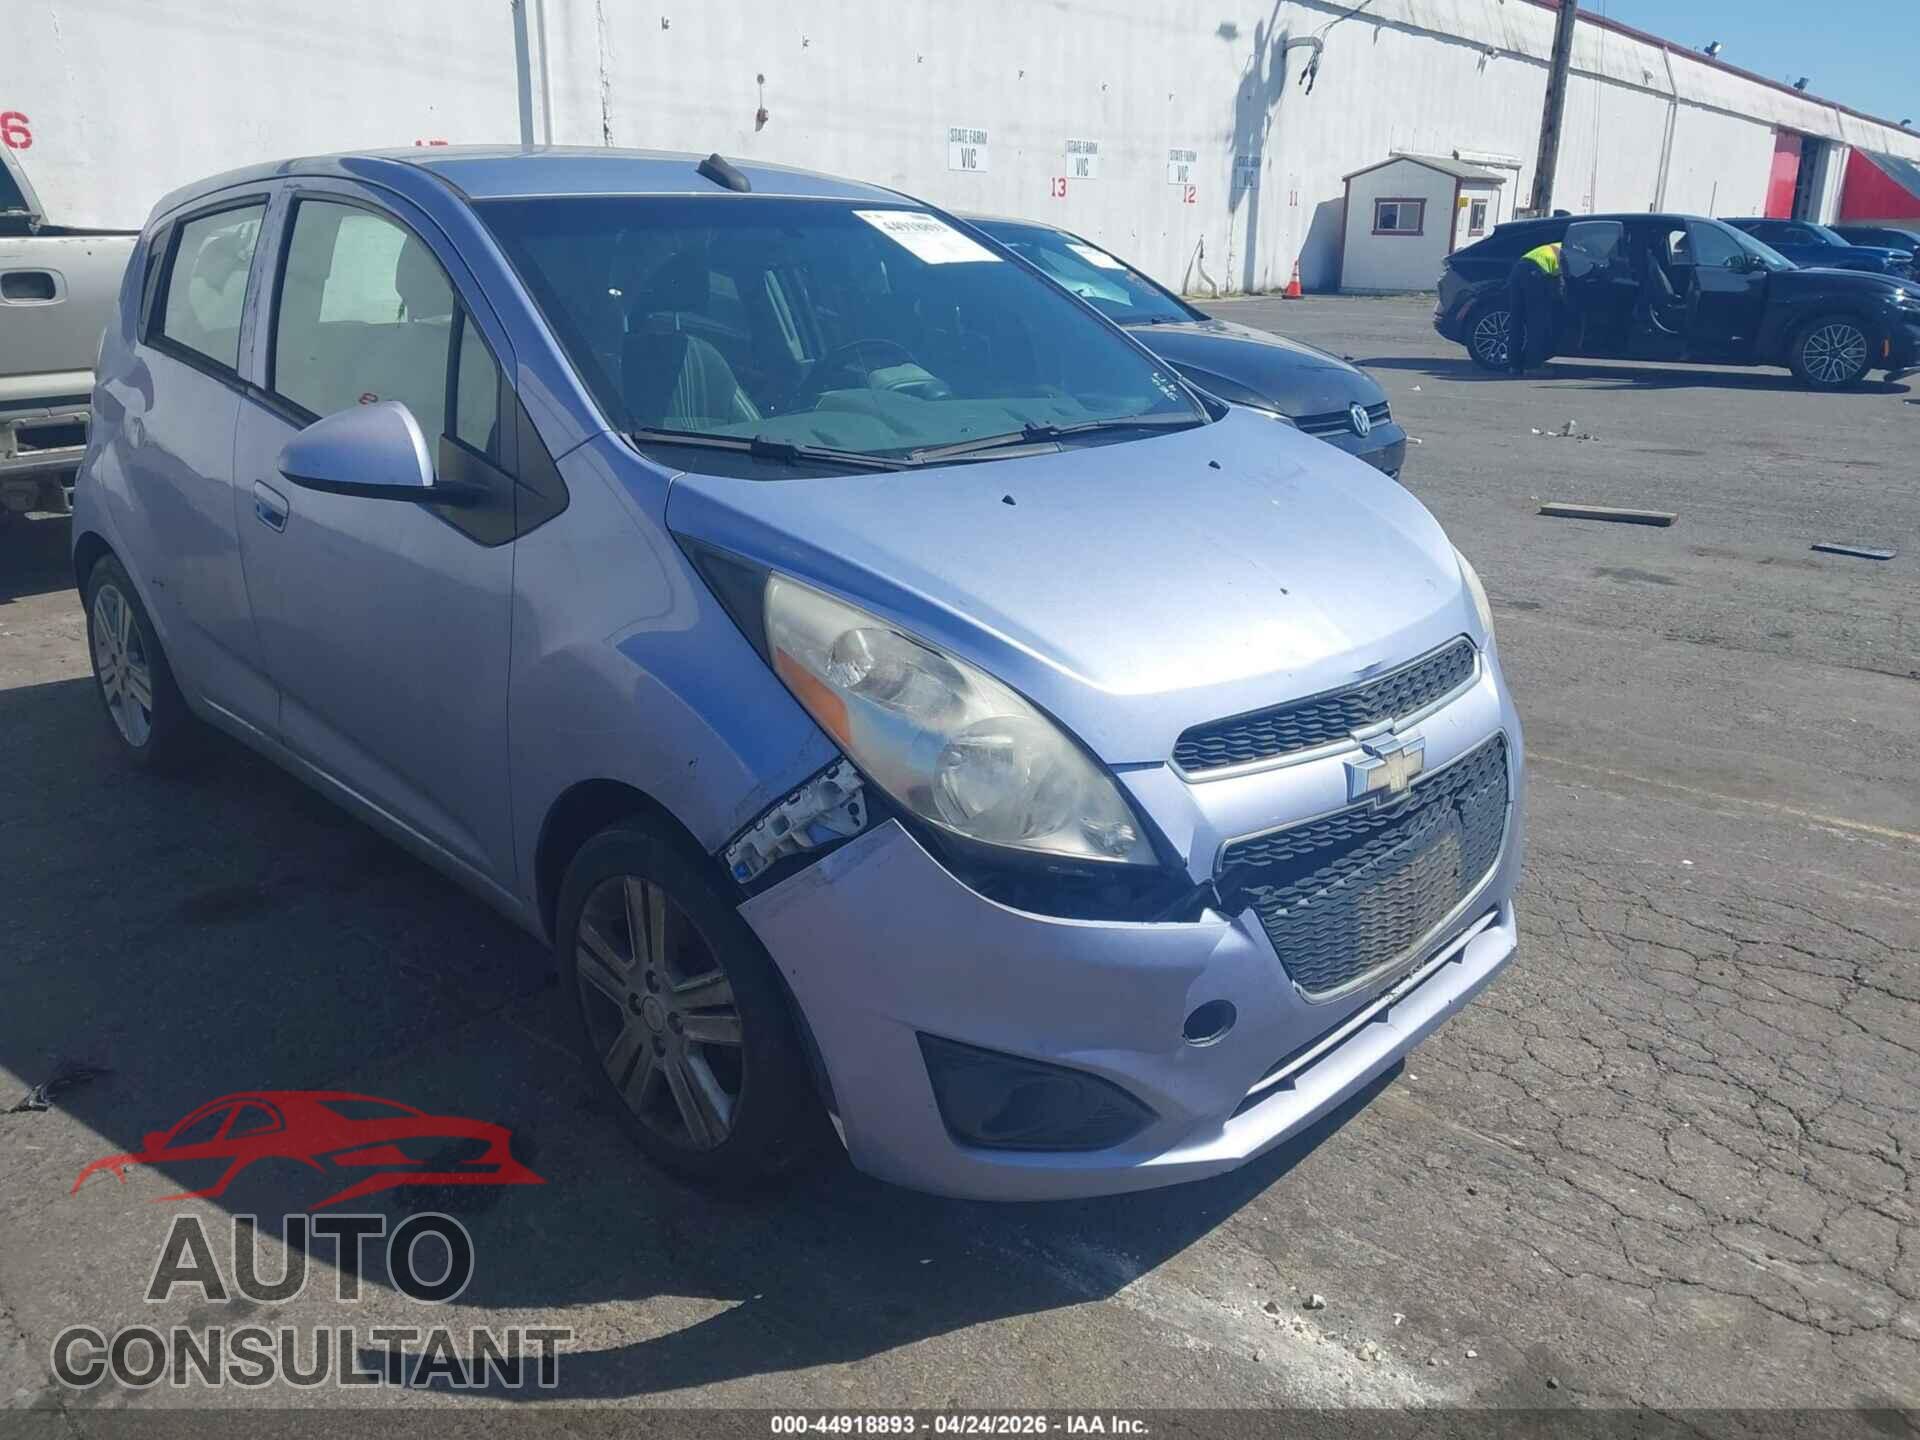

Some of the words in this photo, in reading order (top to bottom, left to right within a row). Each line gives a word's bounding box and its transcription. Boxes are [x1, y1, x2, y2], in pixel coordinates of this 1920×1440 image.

[950, 127, 969, 144] STATE
[969, 129, 988, 145] FARM
[960, 147, 977, 169] VIC
[1075, 157, 1089, 177] VIC
[1051, 177, 1067, 198] 13
[1183, 184, 1197, 204] 12
